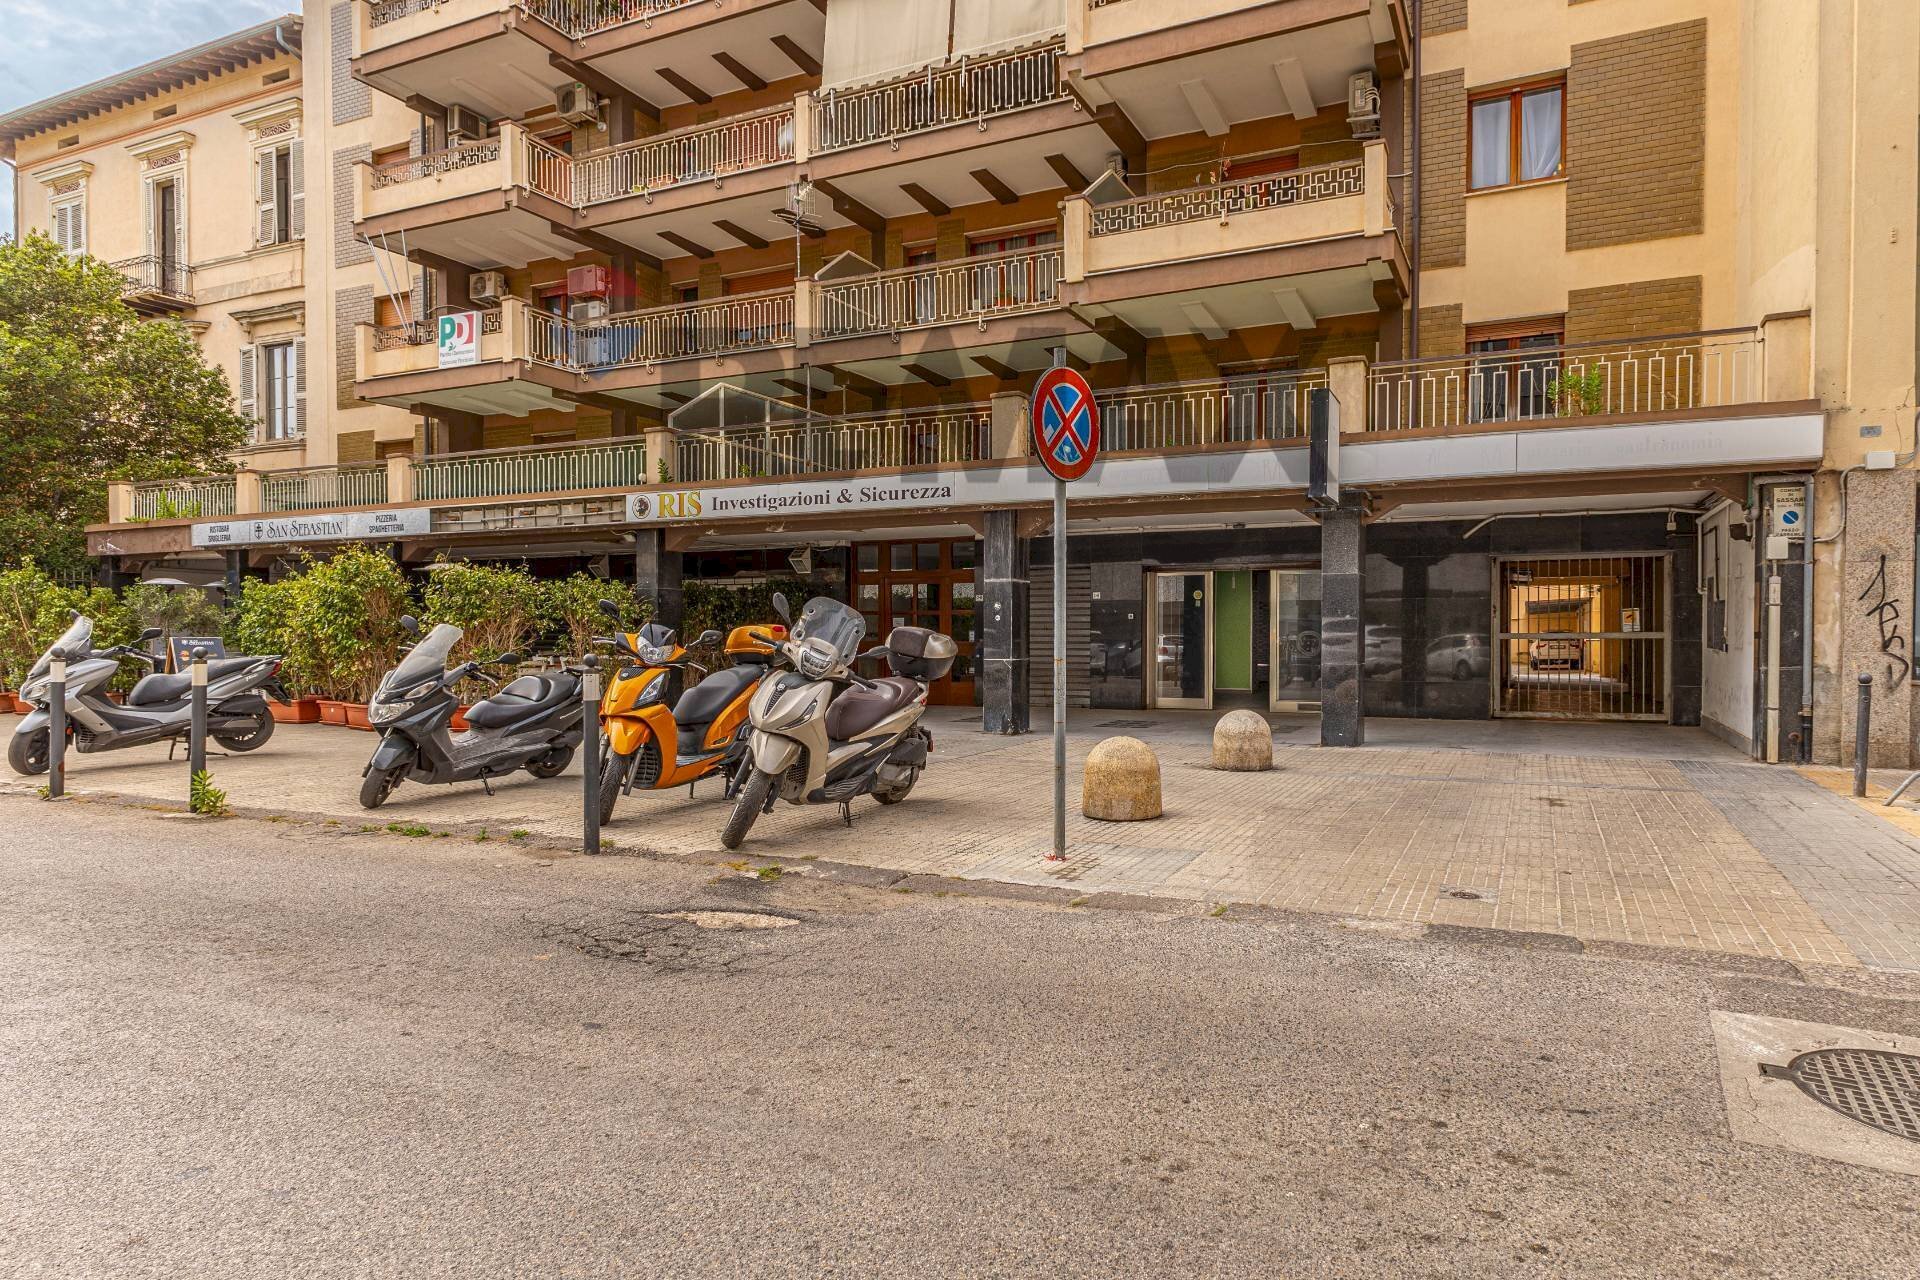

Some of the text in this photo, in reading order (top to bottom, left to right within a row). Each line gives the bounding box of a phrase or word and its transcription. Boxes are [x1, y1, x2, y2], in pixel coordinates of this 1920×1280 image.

[657, 485, 952, 518] RIS Investigazioni & Sicurezza
[375, 513, 398, 523] PIZZERIA
[209, 524, 230, 534] RISTOBAR
[266, 519, 344, 539] SAN SEBASTIAN
[368, 523, 405, 534] SPAGHETTERIA
[207, 533, 231, 543] GRIGLIERIA
